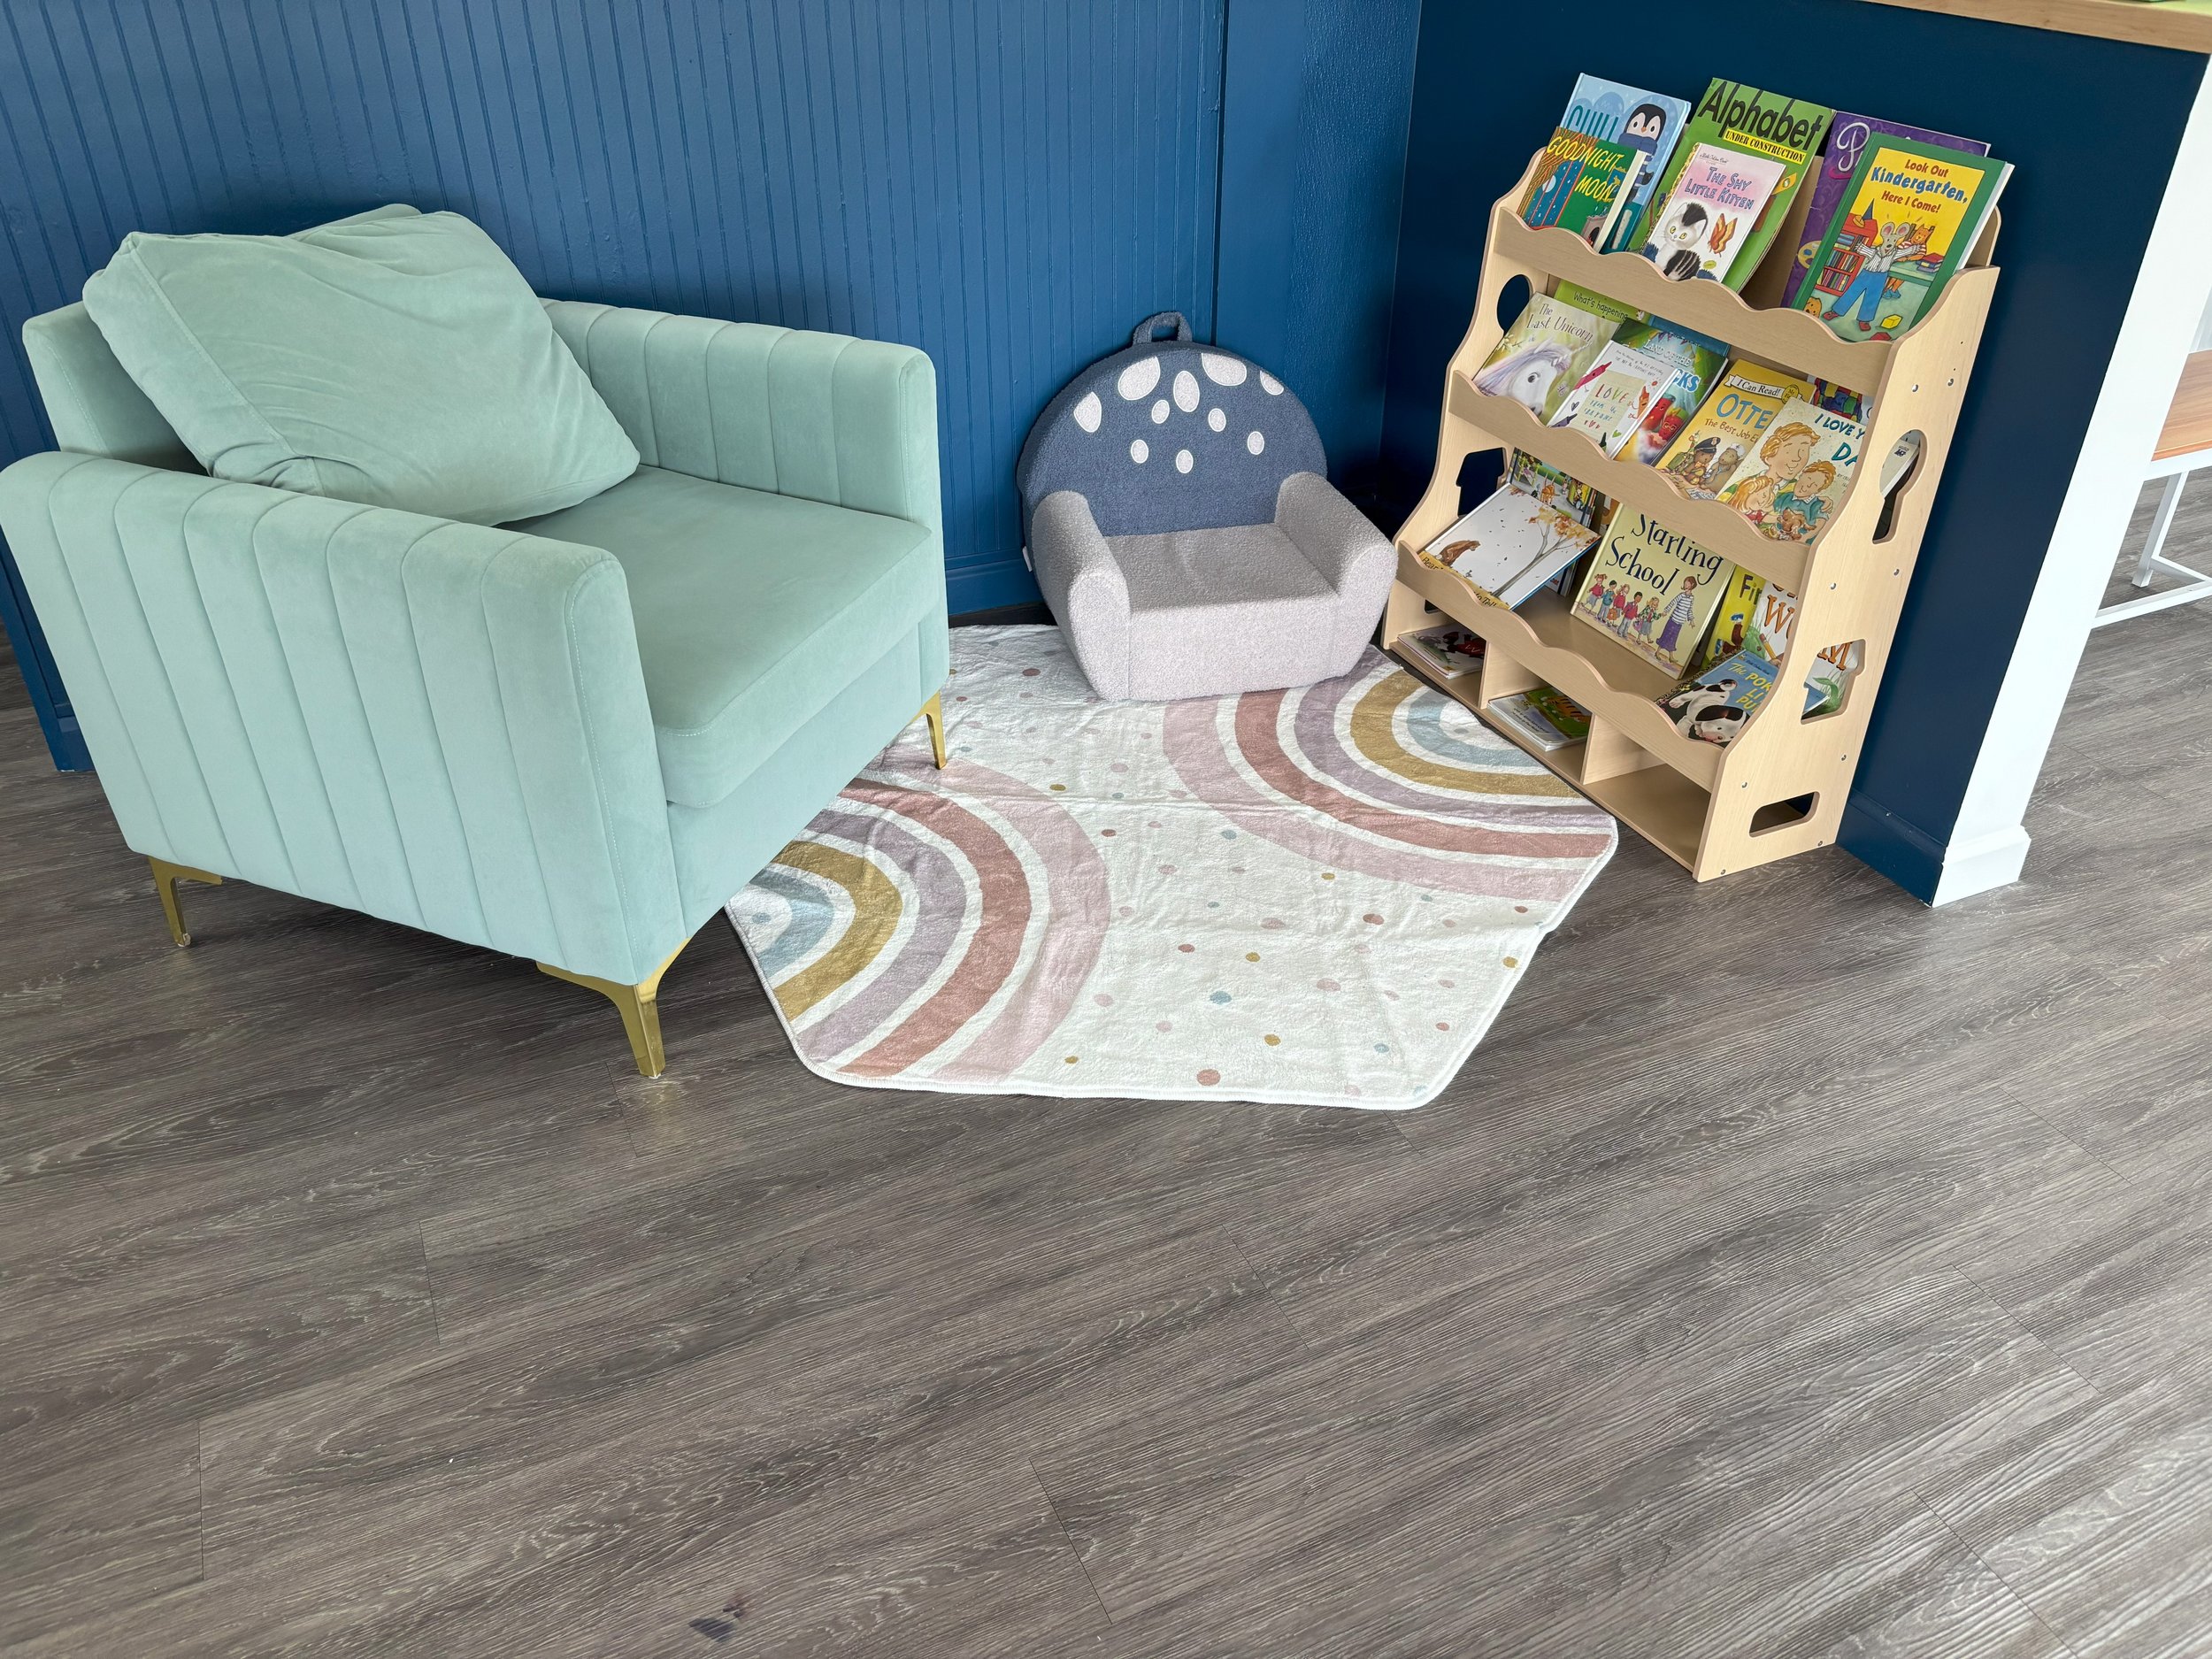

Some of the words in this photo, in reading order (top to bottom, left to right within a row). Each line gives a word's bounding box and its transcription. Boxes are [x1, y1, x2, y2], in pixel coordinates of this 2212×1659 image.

[1698, 81, 1824, 150] Alphabet
[1547, 136, 1624, 172] GOODNIGHT
[1725, 131, 1748, 145] UNDER
[1750, 137, 1805, 163] CONSTRUCTION
[1905, 159, 1928, 173] Look
[1931, 165, 1949, 178] Out
[1575, 175, 1617, 200] MOON
[1870, 166, 1969, 204] Kindergarten,
[1881, 190, 1903, 204] Here
[1905, 196, 1910, 205] I
[1911, 197, 1941, 213] Come!
[1539, 303, 1553, 316] The
[1574, 291, 1595, 308] What's
[1596, 299, 1628, 321] happening
[1527, 314, 1549, 329] Last
[1554, 316, 1594, 342] Unicorn
[1595, 384, 1629, 403] LOVE
[1741, 381, 1756, 392] Can
[1757, 386, 1782, 396] Read!
[1717, 394, 1773, 431] OTTE
[1815, 413, 1824, 424] I
[1823, 417, 1855, 435] LOVE
[1705, 419, 1717, 427] The
[1719, 420, 1736, 434] Best
[1736, 429, 1750, 440] Job
[1605, 535, 1680, 596] School
[1727, 663, 1747, 674] The
[1735, 695, 1761, 712] PU
